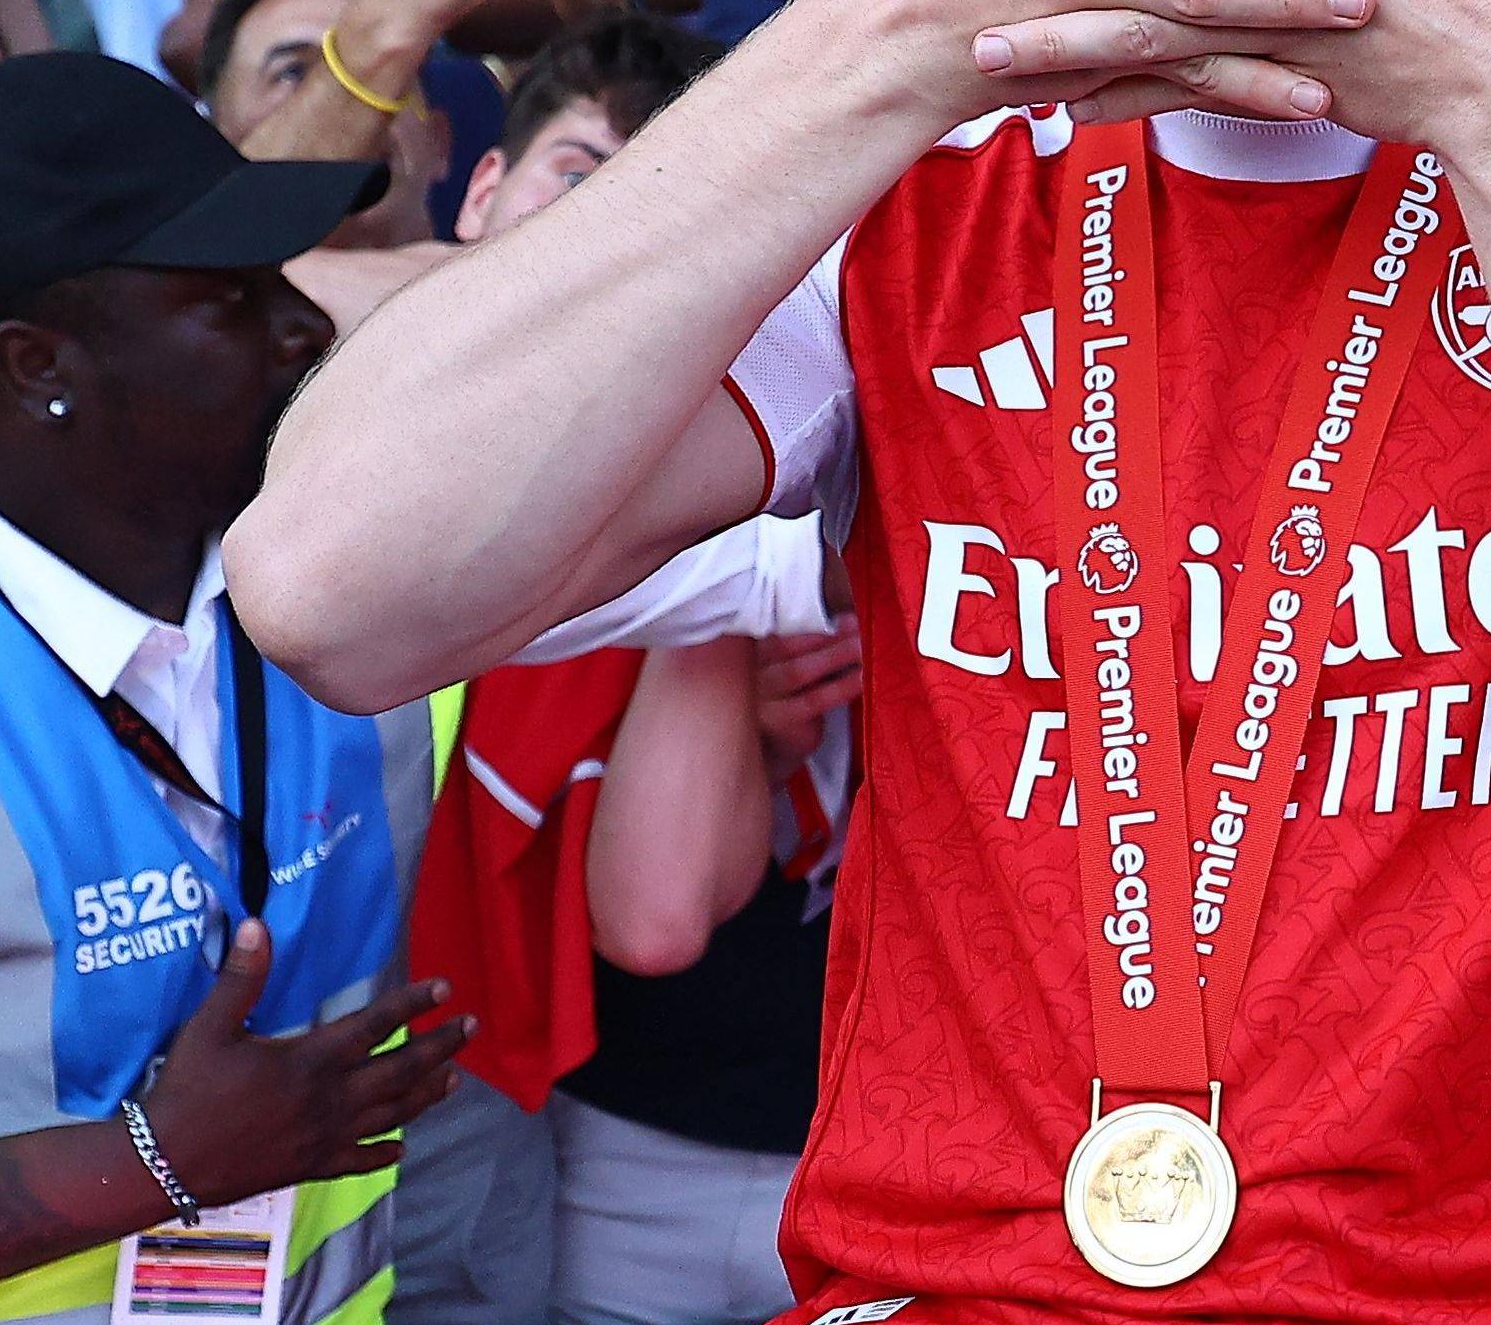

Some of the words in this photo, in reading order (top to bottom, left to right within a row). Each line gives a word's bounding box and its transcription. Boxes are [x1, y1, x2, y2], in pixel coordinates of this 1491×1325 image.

[1080, 164, 1128, 327] Premier
[1287, 313, 1385, 494] Premier
[1347, 150, 1445, 322] League
[1069, 336, 1129, 510] League
[1092, 604, 1149, 803] Premier
[1192, 787, 1253, 988] emier
[1230, 588, 1303, 785] League
[73, 861, 203, 938] 5526
[74, 913, 205, 974] SECURITY
[1101, 810, 1159, 1012] League
